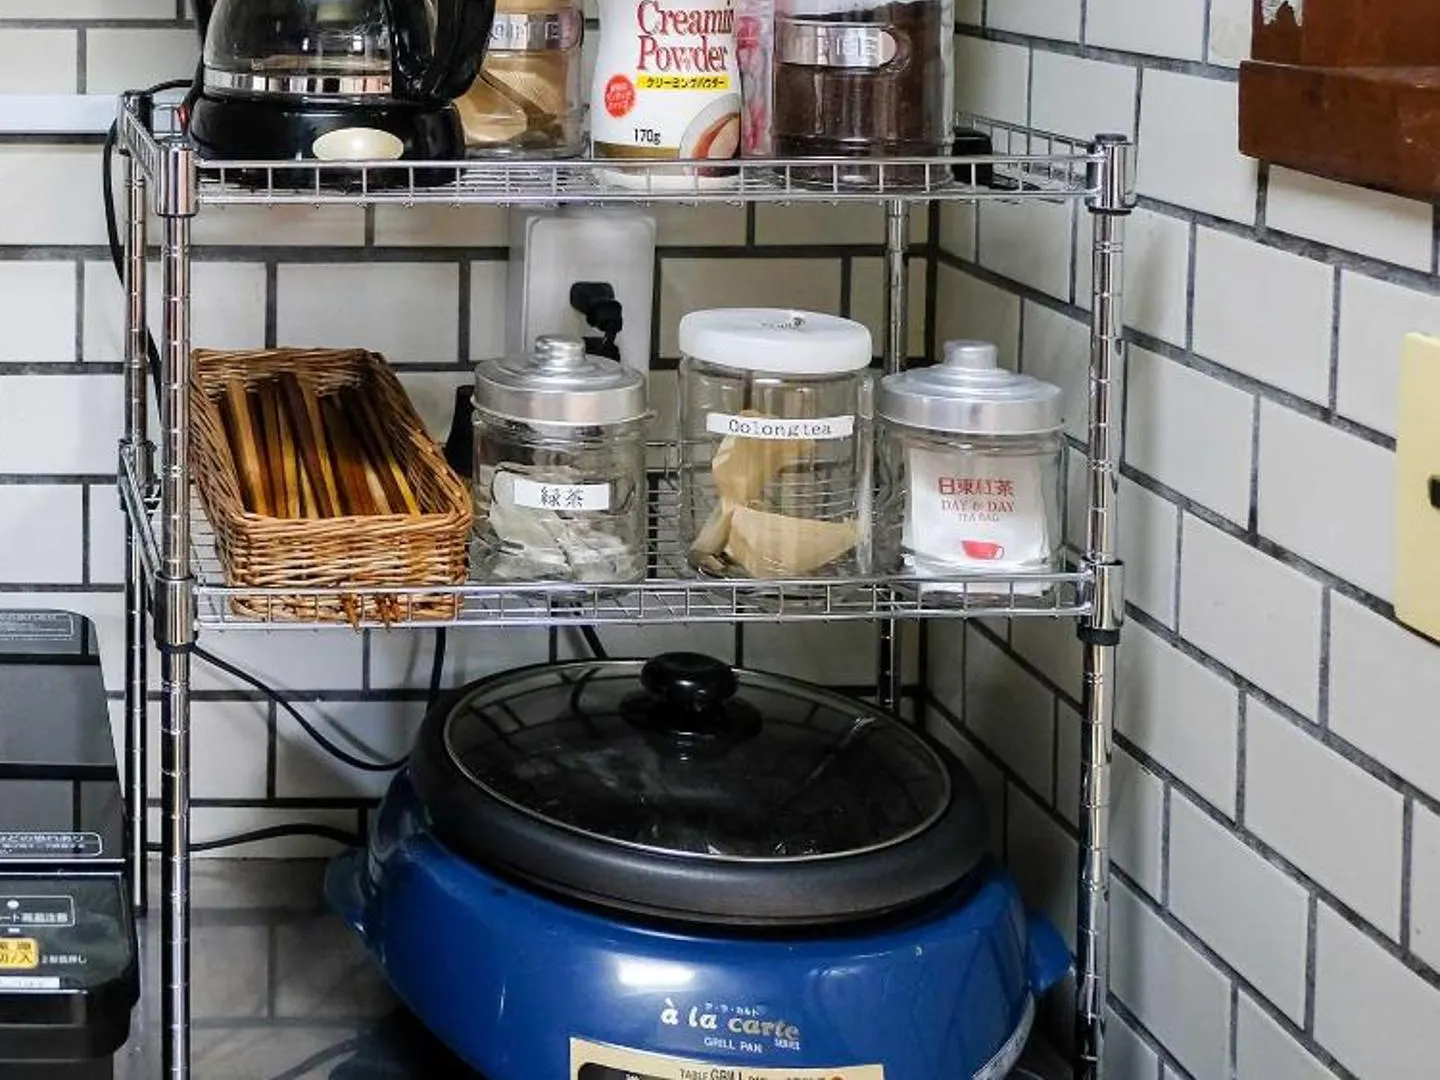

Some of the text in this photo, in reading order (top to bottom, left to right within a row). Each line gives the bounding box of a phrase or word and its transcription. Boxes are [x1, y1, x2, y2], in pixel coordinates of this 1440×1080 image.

[637, 35, 729, 73] Powder
[646, 76, 725, 89] クリーミングパウダー
[634, 128, 661, 145] 170g
[939, 476, 1015, 496] 日東紅茶
[541, 486, 584, 508] 緑茶
[987, 501, 1015, 513] DAY
[660, 997, 801, 1041] à la carte
[704, 1037, 763, 1053] GRILL PAN
